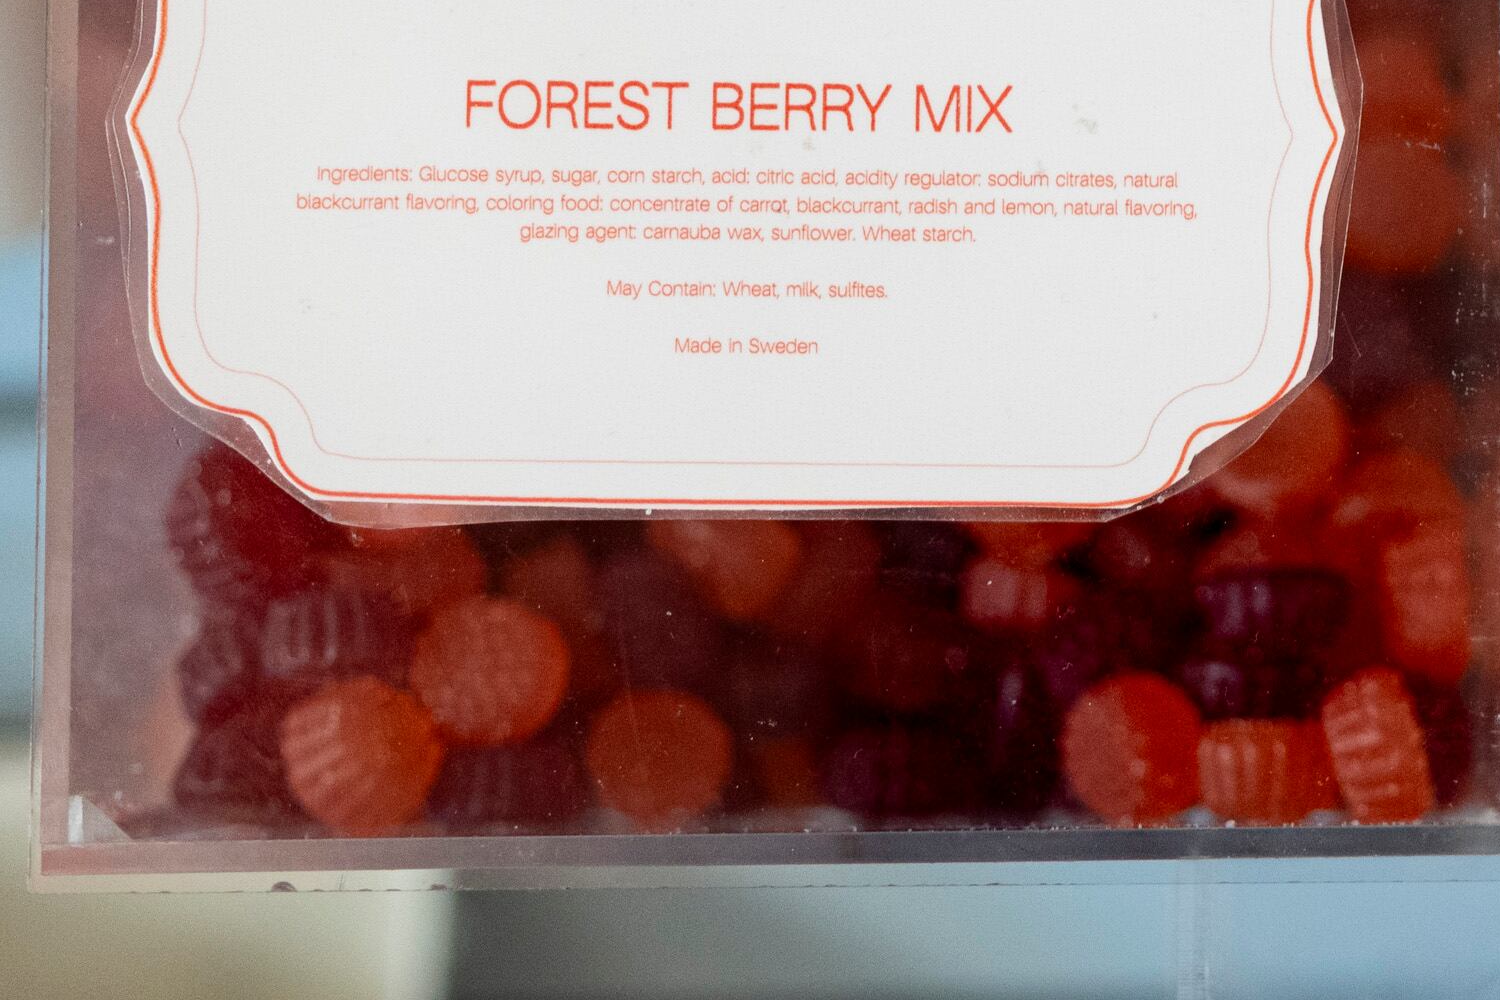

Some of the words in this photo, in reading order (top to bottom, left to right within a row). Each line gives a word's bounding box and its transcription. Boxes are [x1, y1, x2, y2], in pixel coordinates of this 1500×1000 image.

[465, 79, 690, 132] FOREST
[711, 81, 893, 133] BERRY
[915, 84, 1014, 134] MIX
[316, 166, 412, 187] Ingredients:
[418, 164, 491, 185] Glucose
[495, 168, 546, 188] syrup,
[551, 168, 600, 189] sugar,
[607, 169, 646, 185] corn
[651, 168, 706, 186] starch,
[711, 168, 751, 185] acid:
[756, 169, 795, 186] citric
[800, 168, 838, 187] acid,
[843, 170, 899, 191] acidity
[987, 171, 1050, 189] sodium
[1055, 173, 1118, 190] citrates,
[1123, 173, 1179, 190] natural
[295, 194, 401, 211] blackcurrant
[405, 192, 480, 217] flavoring,
[485, 196, 555, 217] coloring
[559, 194, 604, 213] food:
[609, 197, 712, 214] concentrate
[716, 194, 735, 214] of
[739, 199, 790, 216] carrot,
[795, 197, 902, 217] blackcurrant,
[907, 197, 958, 216] radish
[963, 199, 996, 217] and
[1001, 200, 1058, 217] lemon,
[1063, 200, 1119, 217] natural
[1124, 199, 1198, 222] flavoring,
[519, 223, 580, 244] glazing
[642, 224, 722, 241] carnauba
[726, 226, 766, 243] wax,
[770, 223, 854, 243] sunflower.
[862, 225, 917, 243] Wheat
[922, 227, 976, 243] starch.
[607, 280, 643, 300] May
[647, 280, 716, 298] Contain:
[722, 280, 779, 299] Wheat,
[785, 281, 822, 301] milk,
[827, 280, 889, 300] sulfites.
[674, 336, 723, 355] Made
[728, 339, 743, 354] in
[748, 336, 819, 356] Sweden
